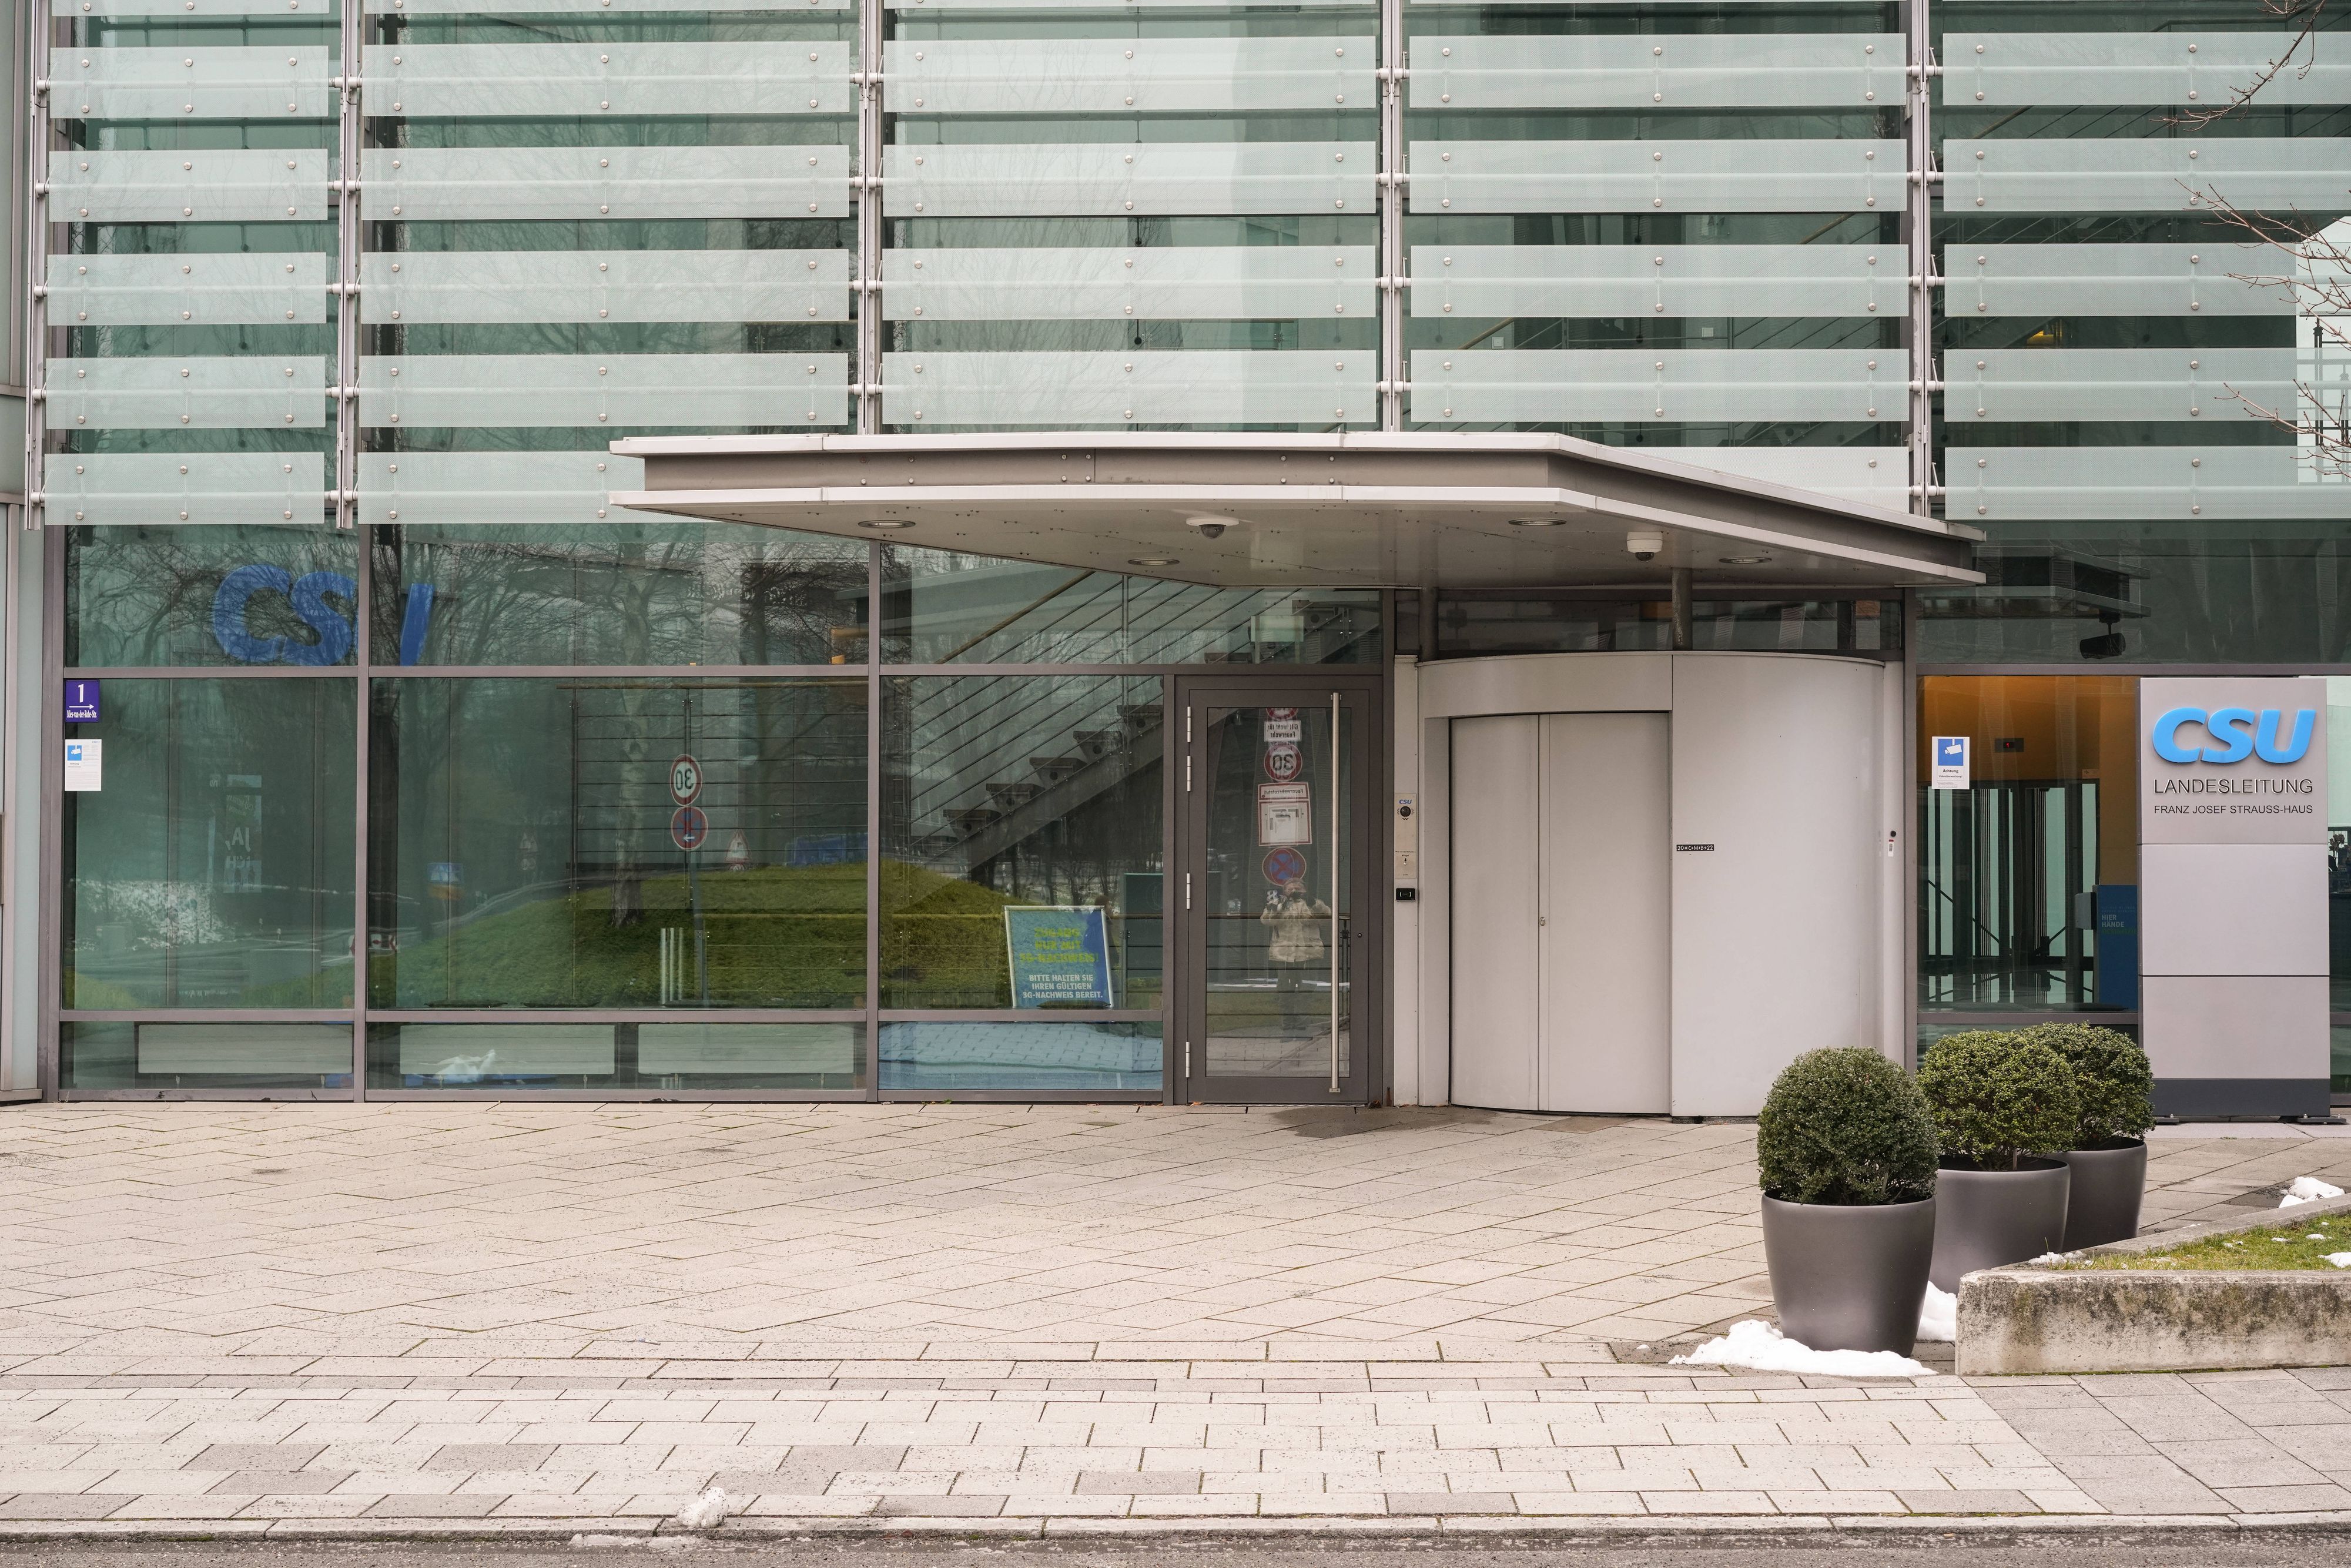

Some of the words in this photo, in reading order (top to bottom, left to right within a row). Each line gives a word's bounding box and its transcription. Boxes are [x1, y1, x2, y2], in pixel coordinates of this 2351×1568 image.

[78, 684, 84, 703] 1
[2152, 708, 2316, 764] CSU
[2154, 779, 2313, 795] LANDESLEITUNG
[2154, 805, 2189, 814] FRANZ
[2192, 805, 2227, 814] JOSEF
[2230, 805, 2313, 814] STRAUSS-HAUS
[1056, 981, 1091, 990] GÜLTIGEN
